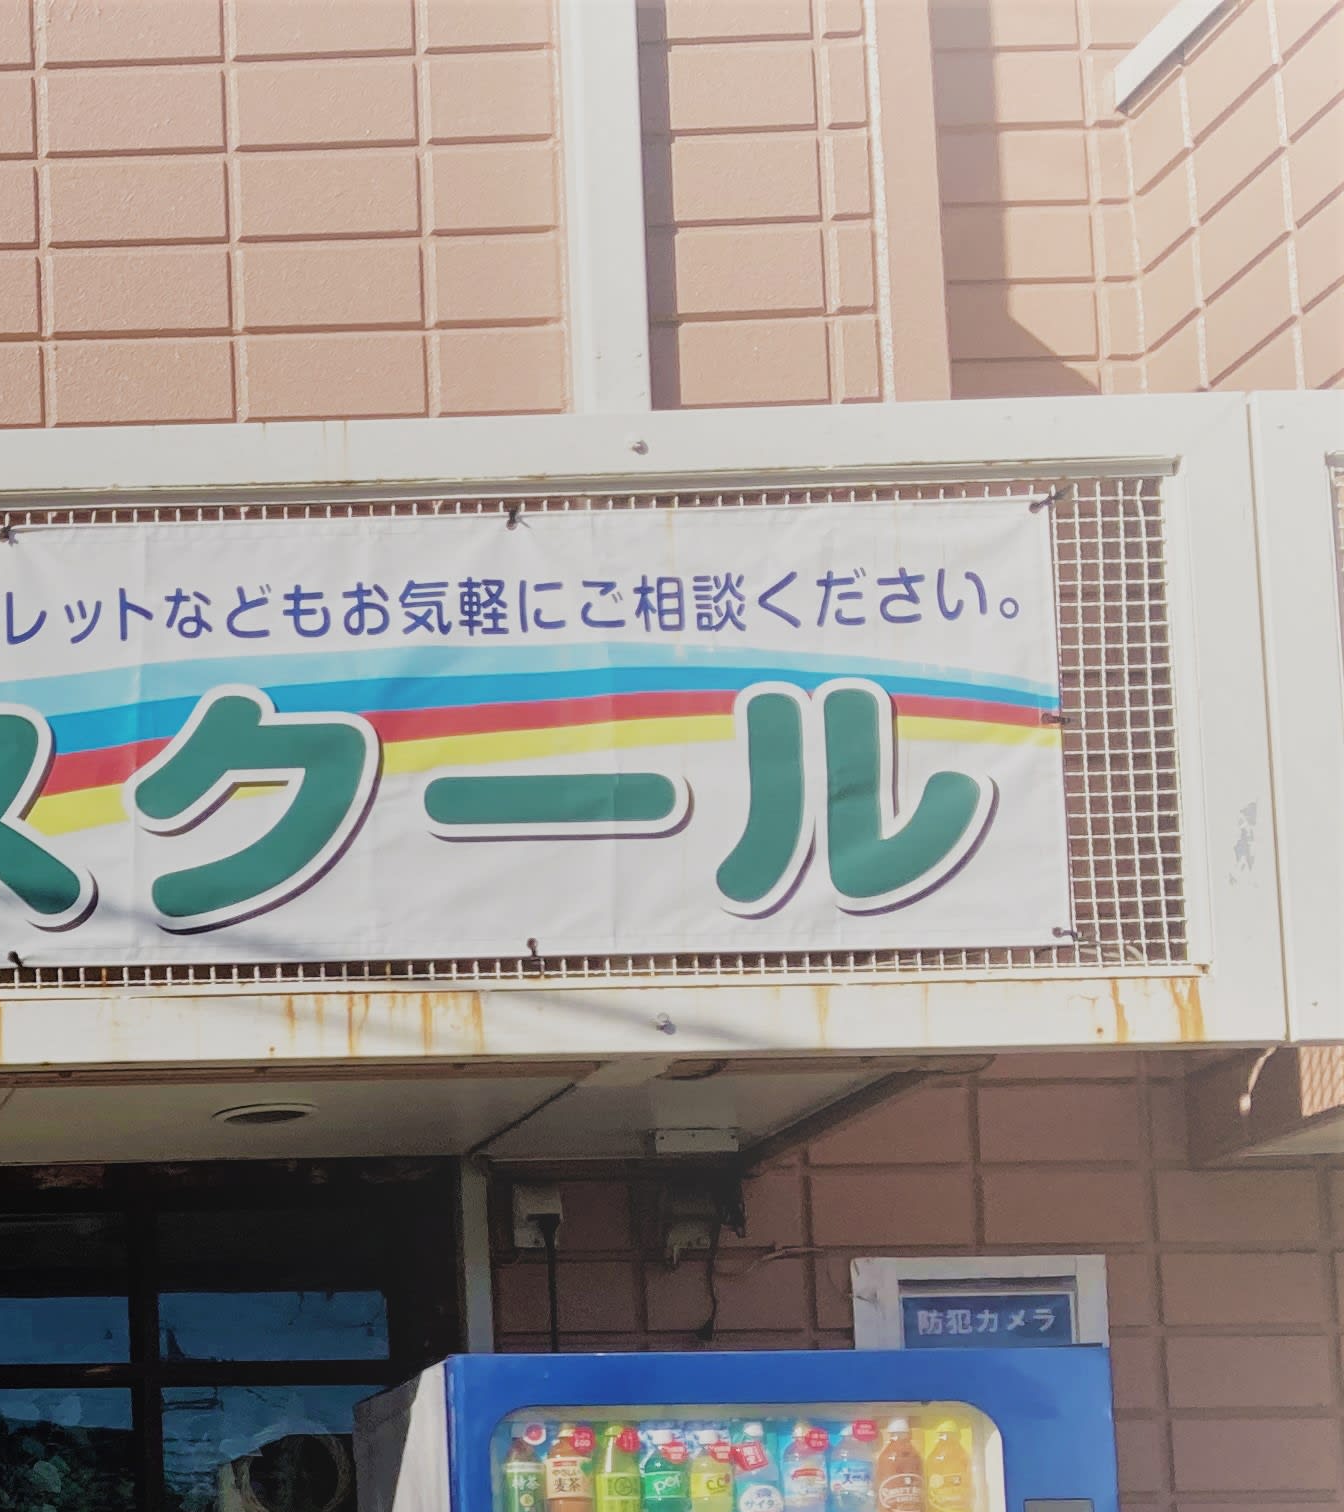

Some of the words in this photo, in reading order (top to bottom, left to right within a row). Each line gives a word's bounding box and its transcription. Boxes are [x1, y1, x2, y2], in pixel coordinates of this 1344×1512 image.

[917, 1308, 1056, 1336] 防犯カメラ
